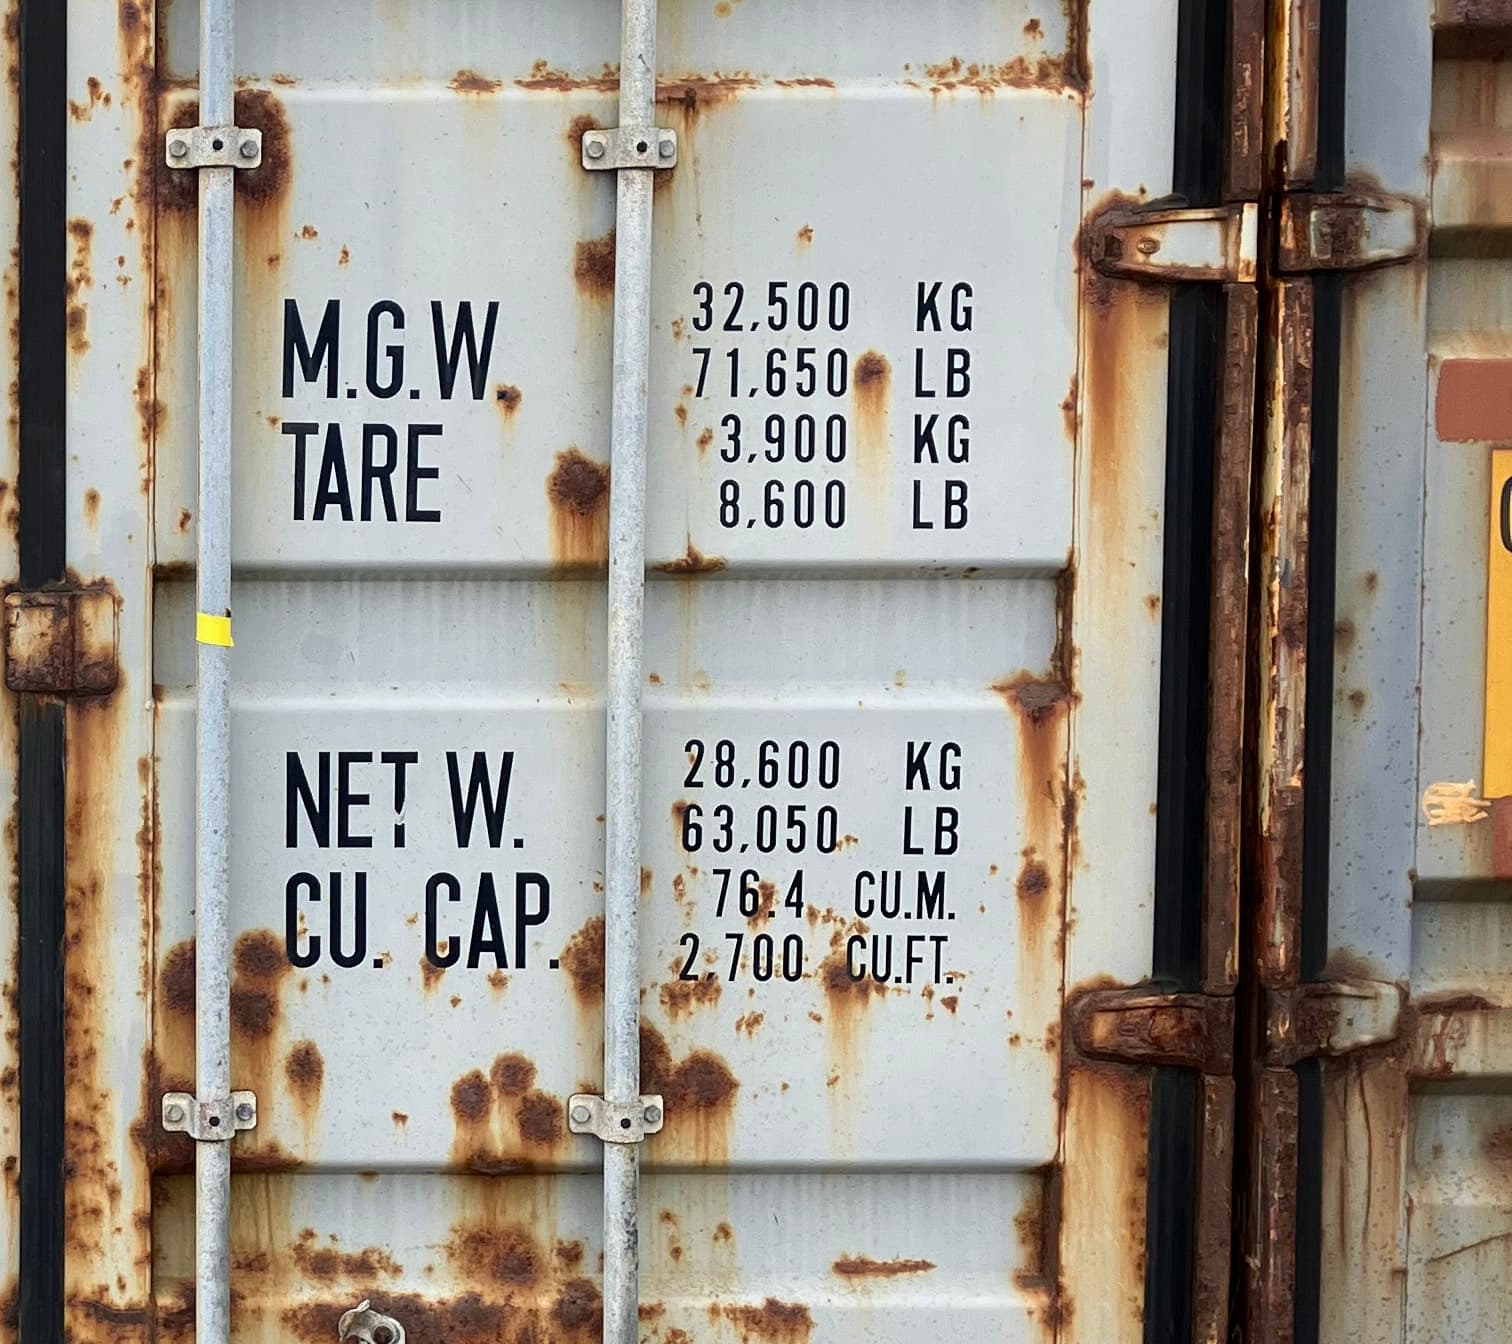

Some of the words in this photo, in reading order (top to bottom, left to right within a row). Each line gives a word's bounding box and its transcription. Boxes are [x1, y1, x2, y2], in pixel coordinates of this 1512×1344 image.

[692, 281, 849, 333] 32,500
[916, 281, 974, 333] KG
[691, 348, 848, 400] 71,650
[915, 348, 970, 398] LB
[719, 414, 847, 465] 3,900
[913, 414, 970, 464] KG
[281, 423, 443, 524] TARE
[719, 480, 846, 531] 8,600
[912, 480, 968, 530] LB
[683, 740, 840, 791] 28,600
[906, 741, 962, 791] KG
[285, 751, 419, 849] NET
[445, 751, 524, 849] W.
[681, 805, 839, 855] 63,050
[903, 806, 960, 856] LB
[287, 871, 384, 969] CU.
[425, 871, 560, 969] CAP.
[712, 869, 805, 918] 76.4
[855, 870, 956, 920] CU.M.
[679, 933, 804, 982] 2,700
[846, 935, 954, 984] CU.FT.
